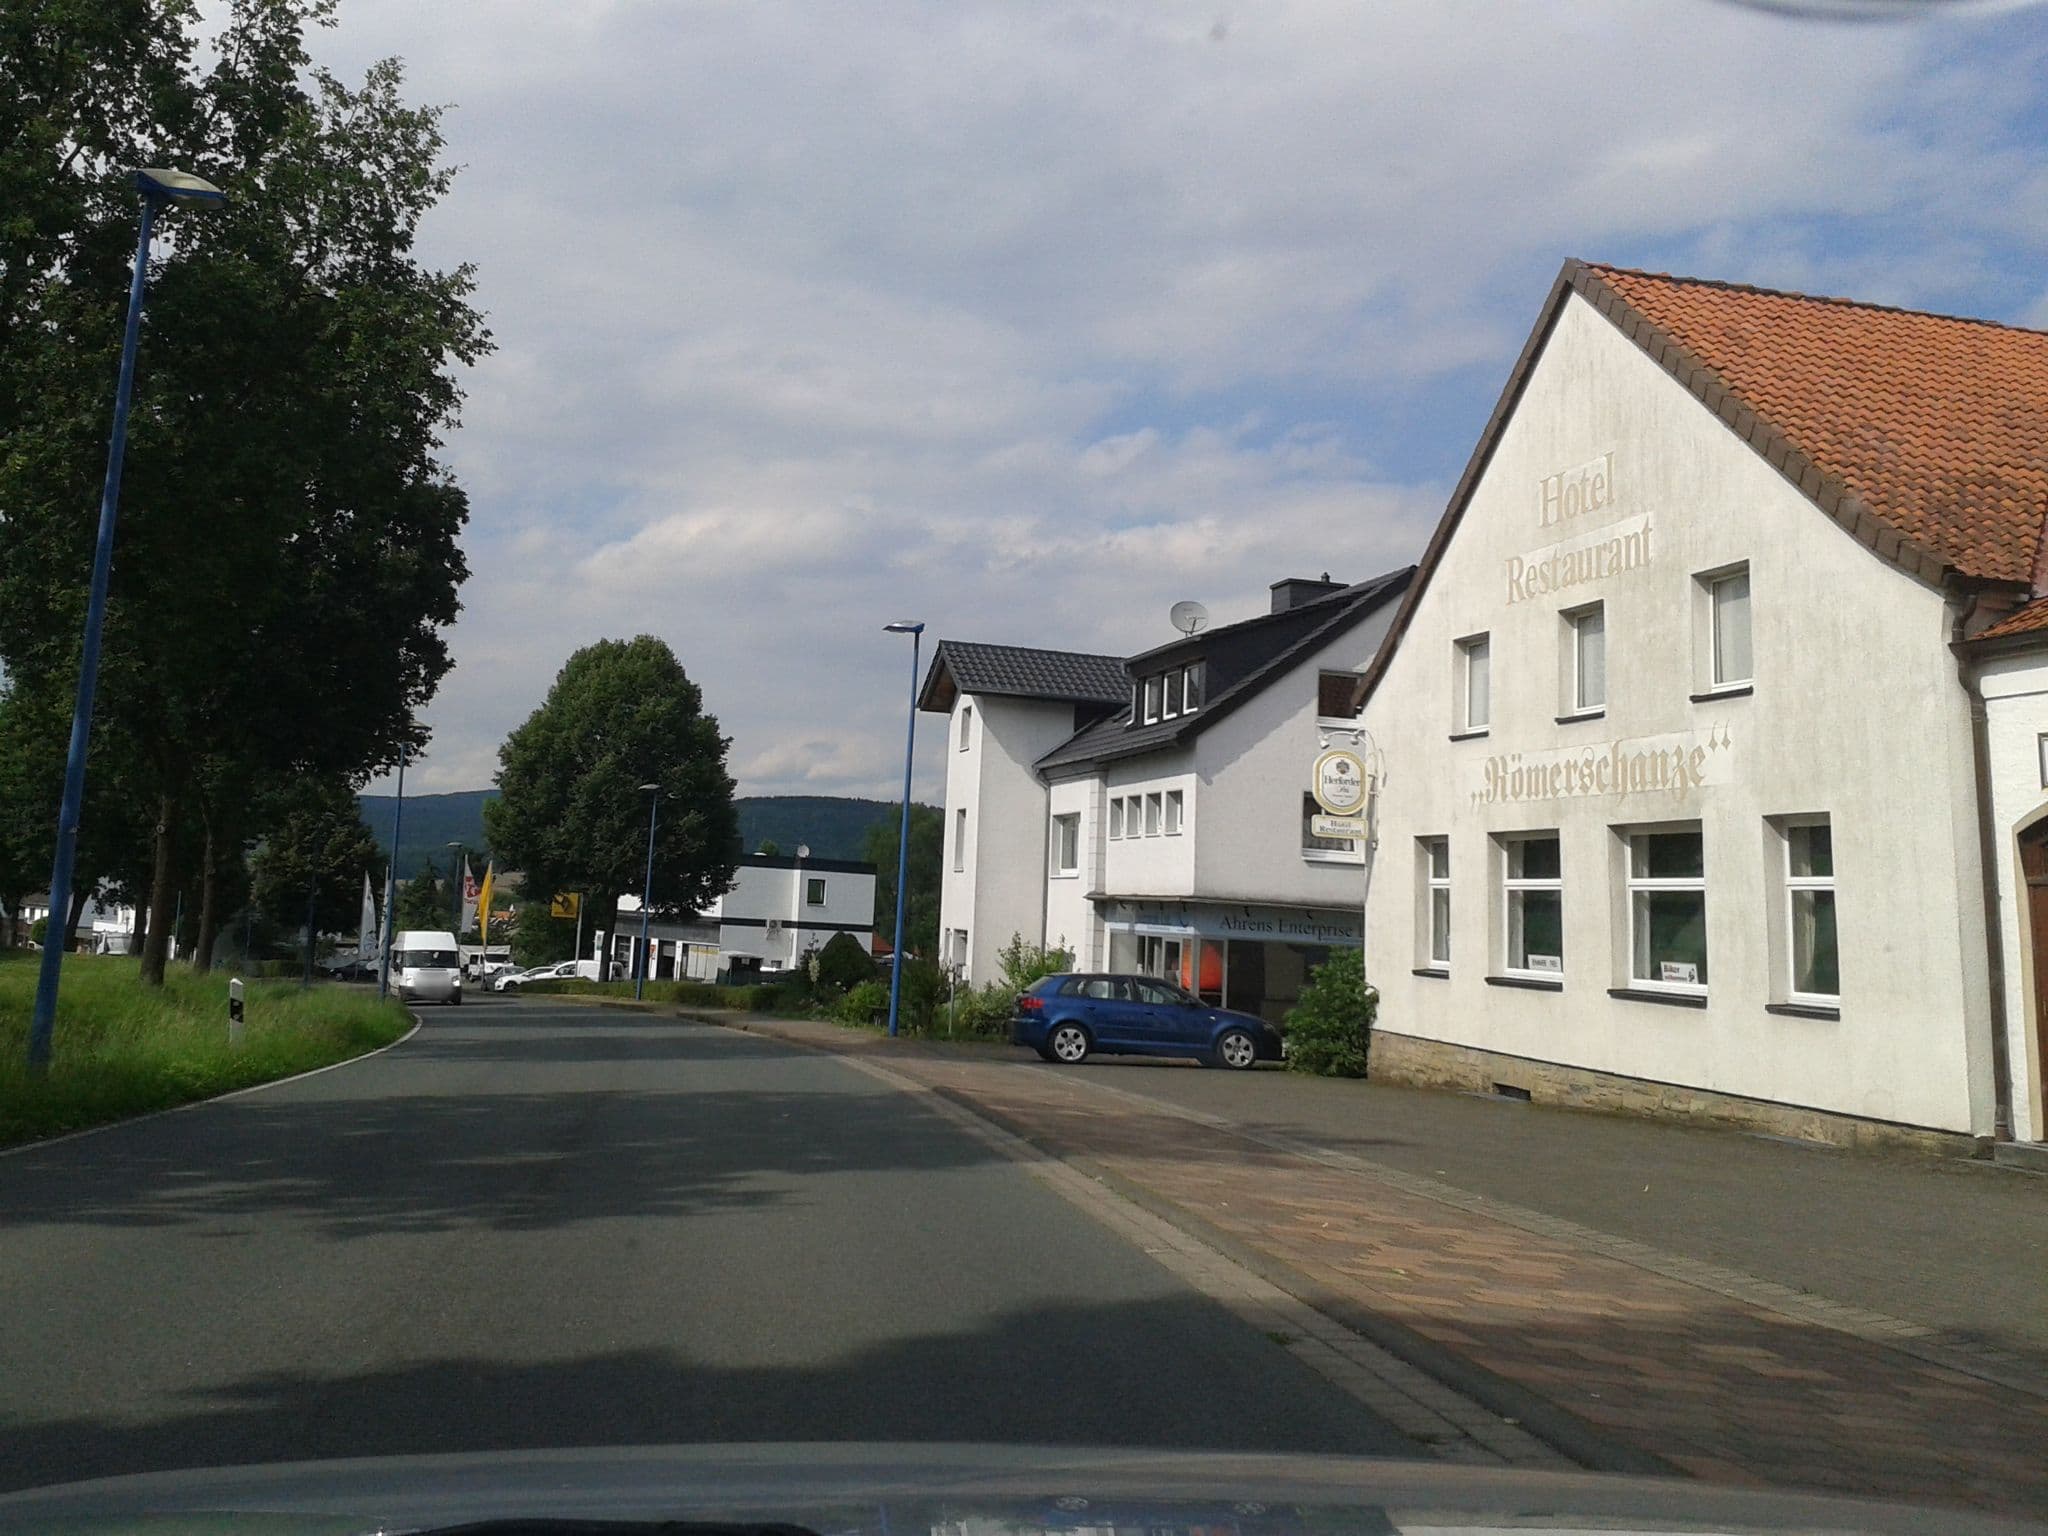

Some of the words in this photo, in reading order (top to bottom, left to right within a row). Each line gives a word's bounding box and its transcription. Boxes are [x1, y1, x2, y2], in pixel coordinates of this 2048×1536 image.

[1540, 452, 1616, 528] Hotel
[1505, 518, 1653, 605] Restaurant
[1219, 914, 1273, 934] Ahrens
[1278, 919, 1353, 942] Enterprise
